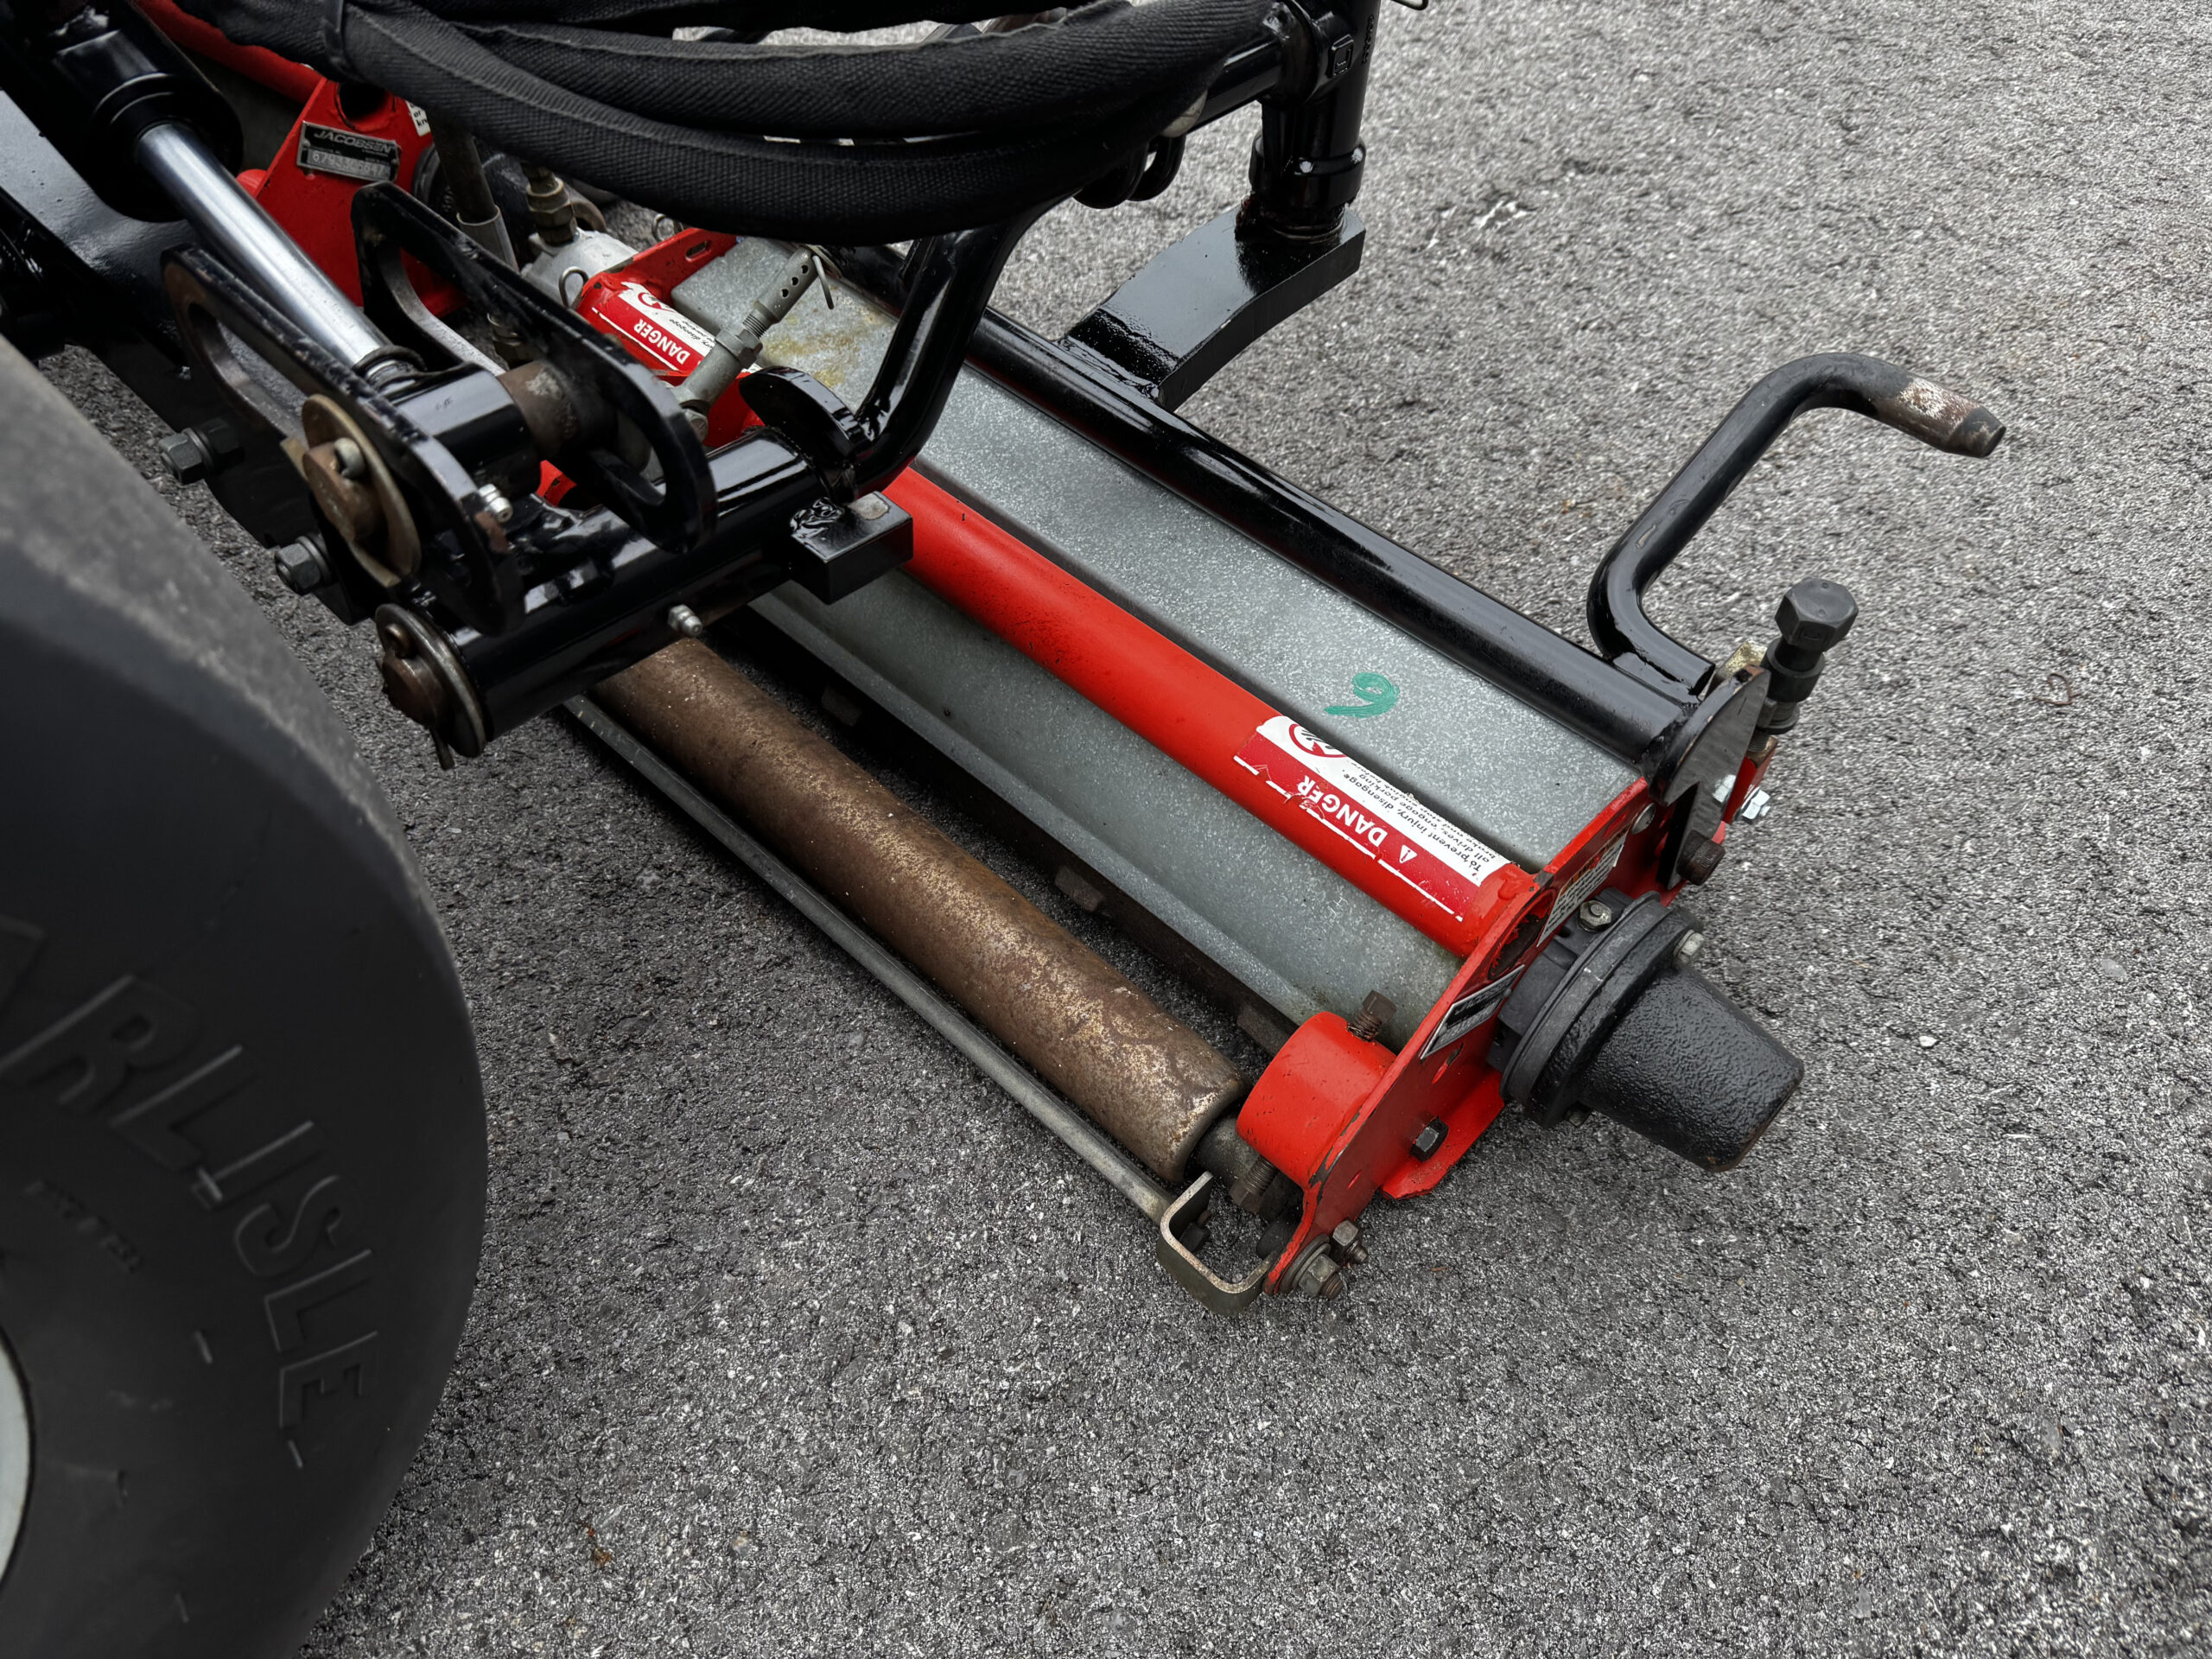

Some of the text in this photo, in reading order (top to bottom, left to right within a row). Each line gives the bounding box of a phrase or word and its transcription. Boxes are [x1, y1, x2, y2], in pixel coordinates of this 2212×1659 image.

[315, 130, 392, 153] JACOBSEN
[632, 319, 690, 364] DANGER
[1297, 775, 1388, 847] DANGER
[1395, 809, 1428, 834] injury,
[1427, 831, 1469, 862] prevent
[1474, 851, 1490, 864] all
[1470, 860, 1482, 871] To
